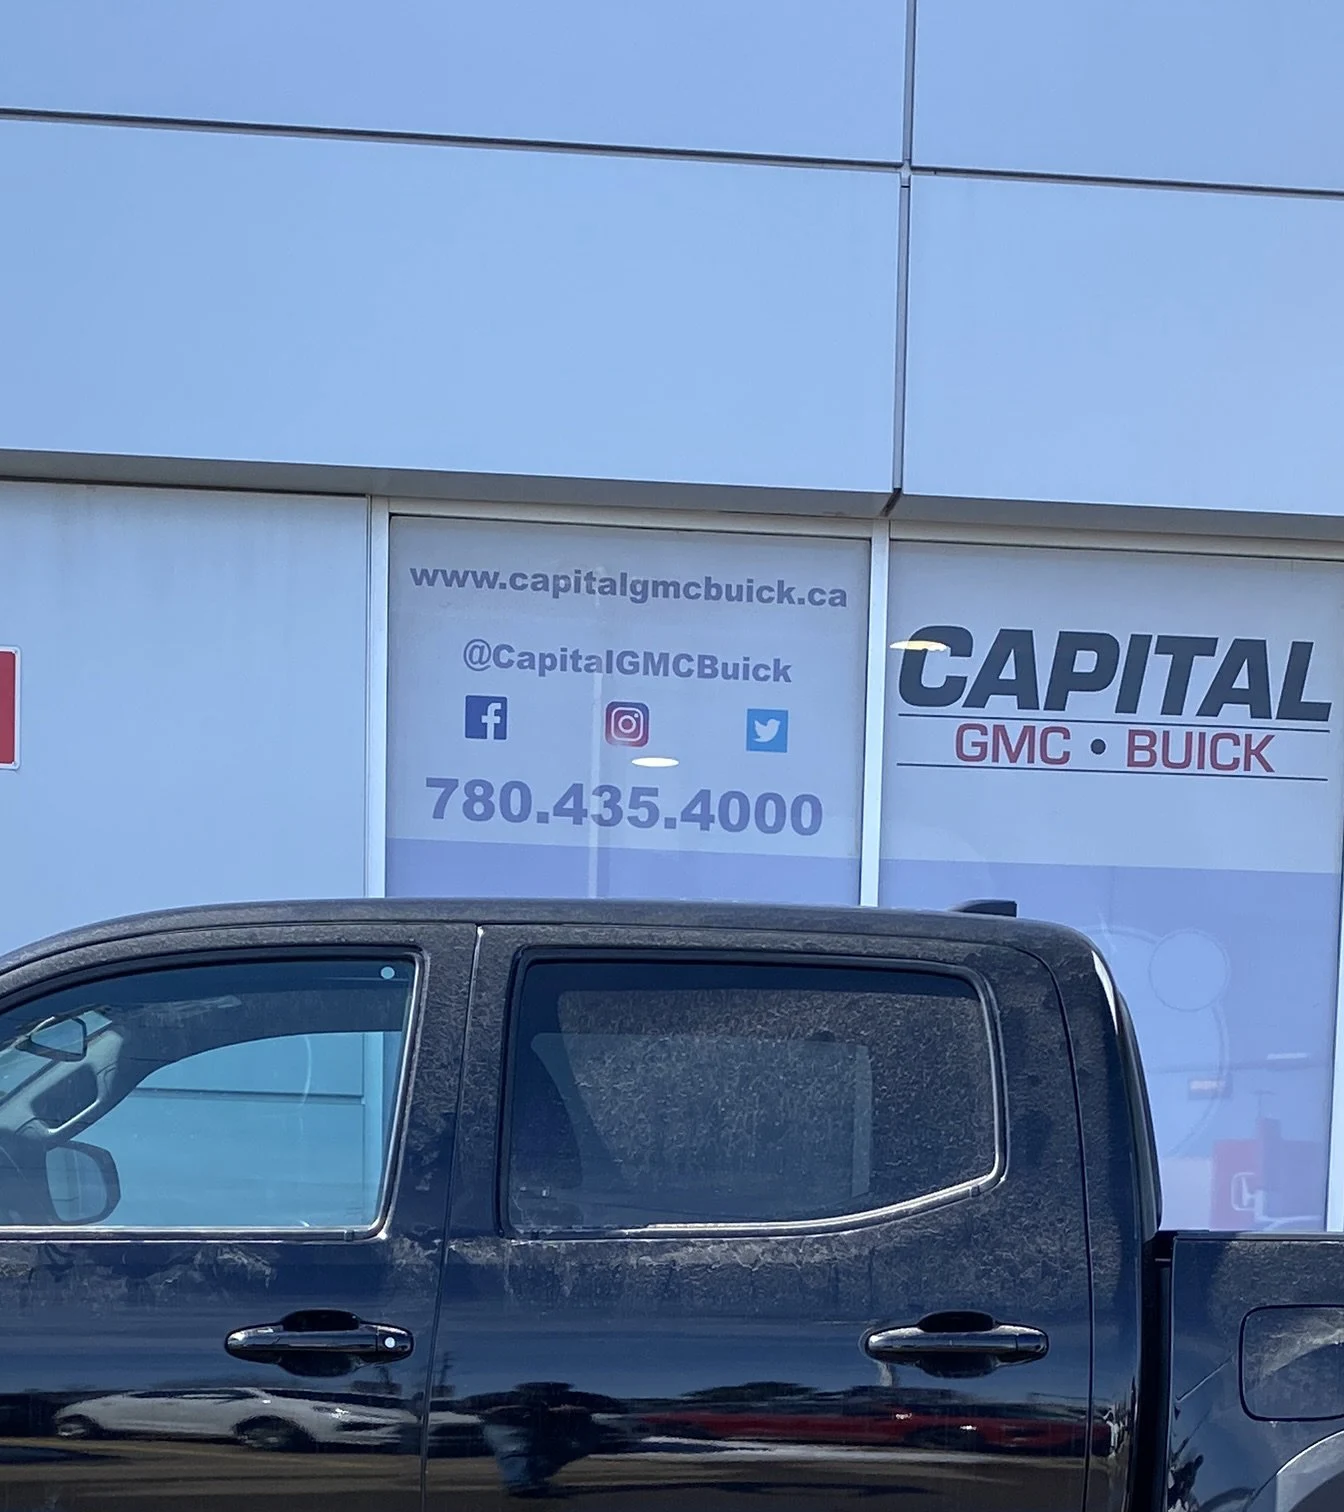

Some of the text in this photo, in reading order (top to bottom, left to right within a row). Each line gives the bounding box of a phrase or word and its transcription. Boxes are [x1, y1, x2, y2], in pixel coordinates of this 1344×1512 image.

[409, 566, 848, 608] www.capitalgmcbuick.ca
[463, 638, 793, 684] @CapitalGMCBuick
[898, 624, 1333, 722] CAPITAL
[955, 722, 1275, 773] GMC BUICK
[425, 776, 824, 836] 780.435.4000
